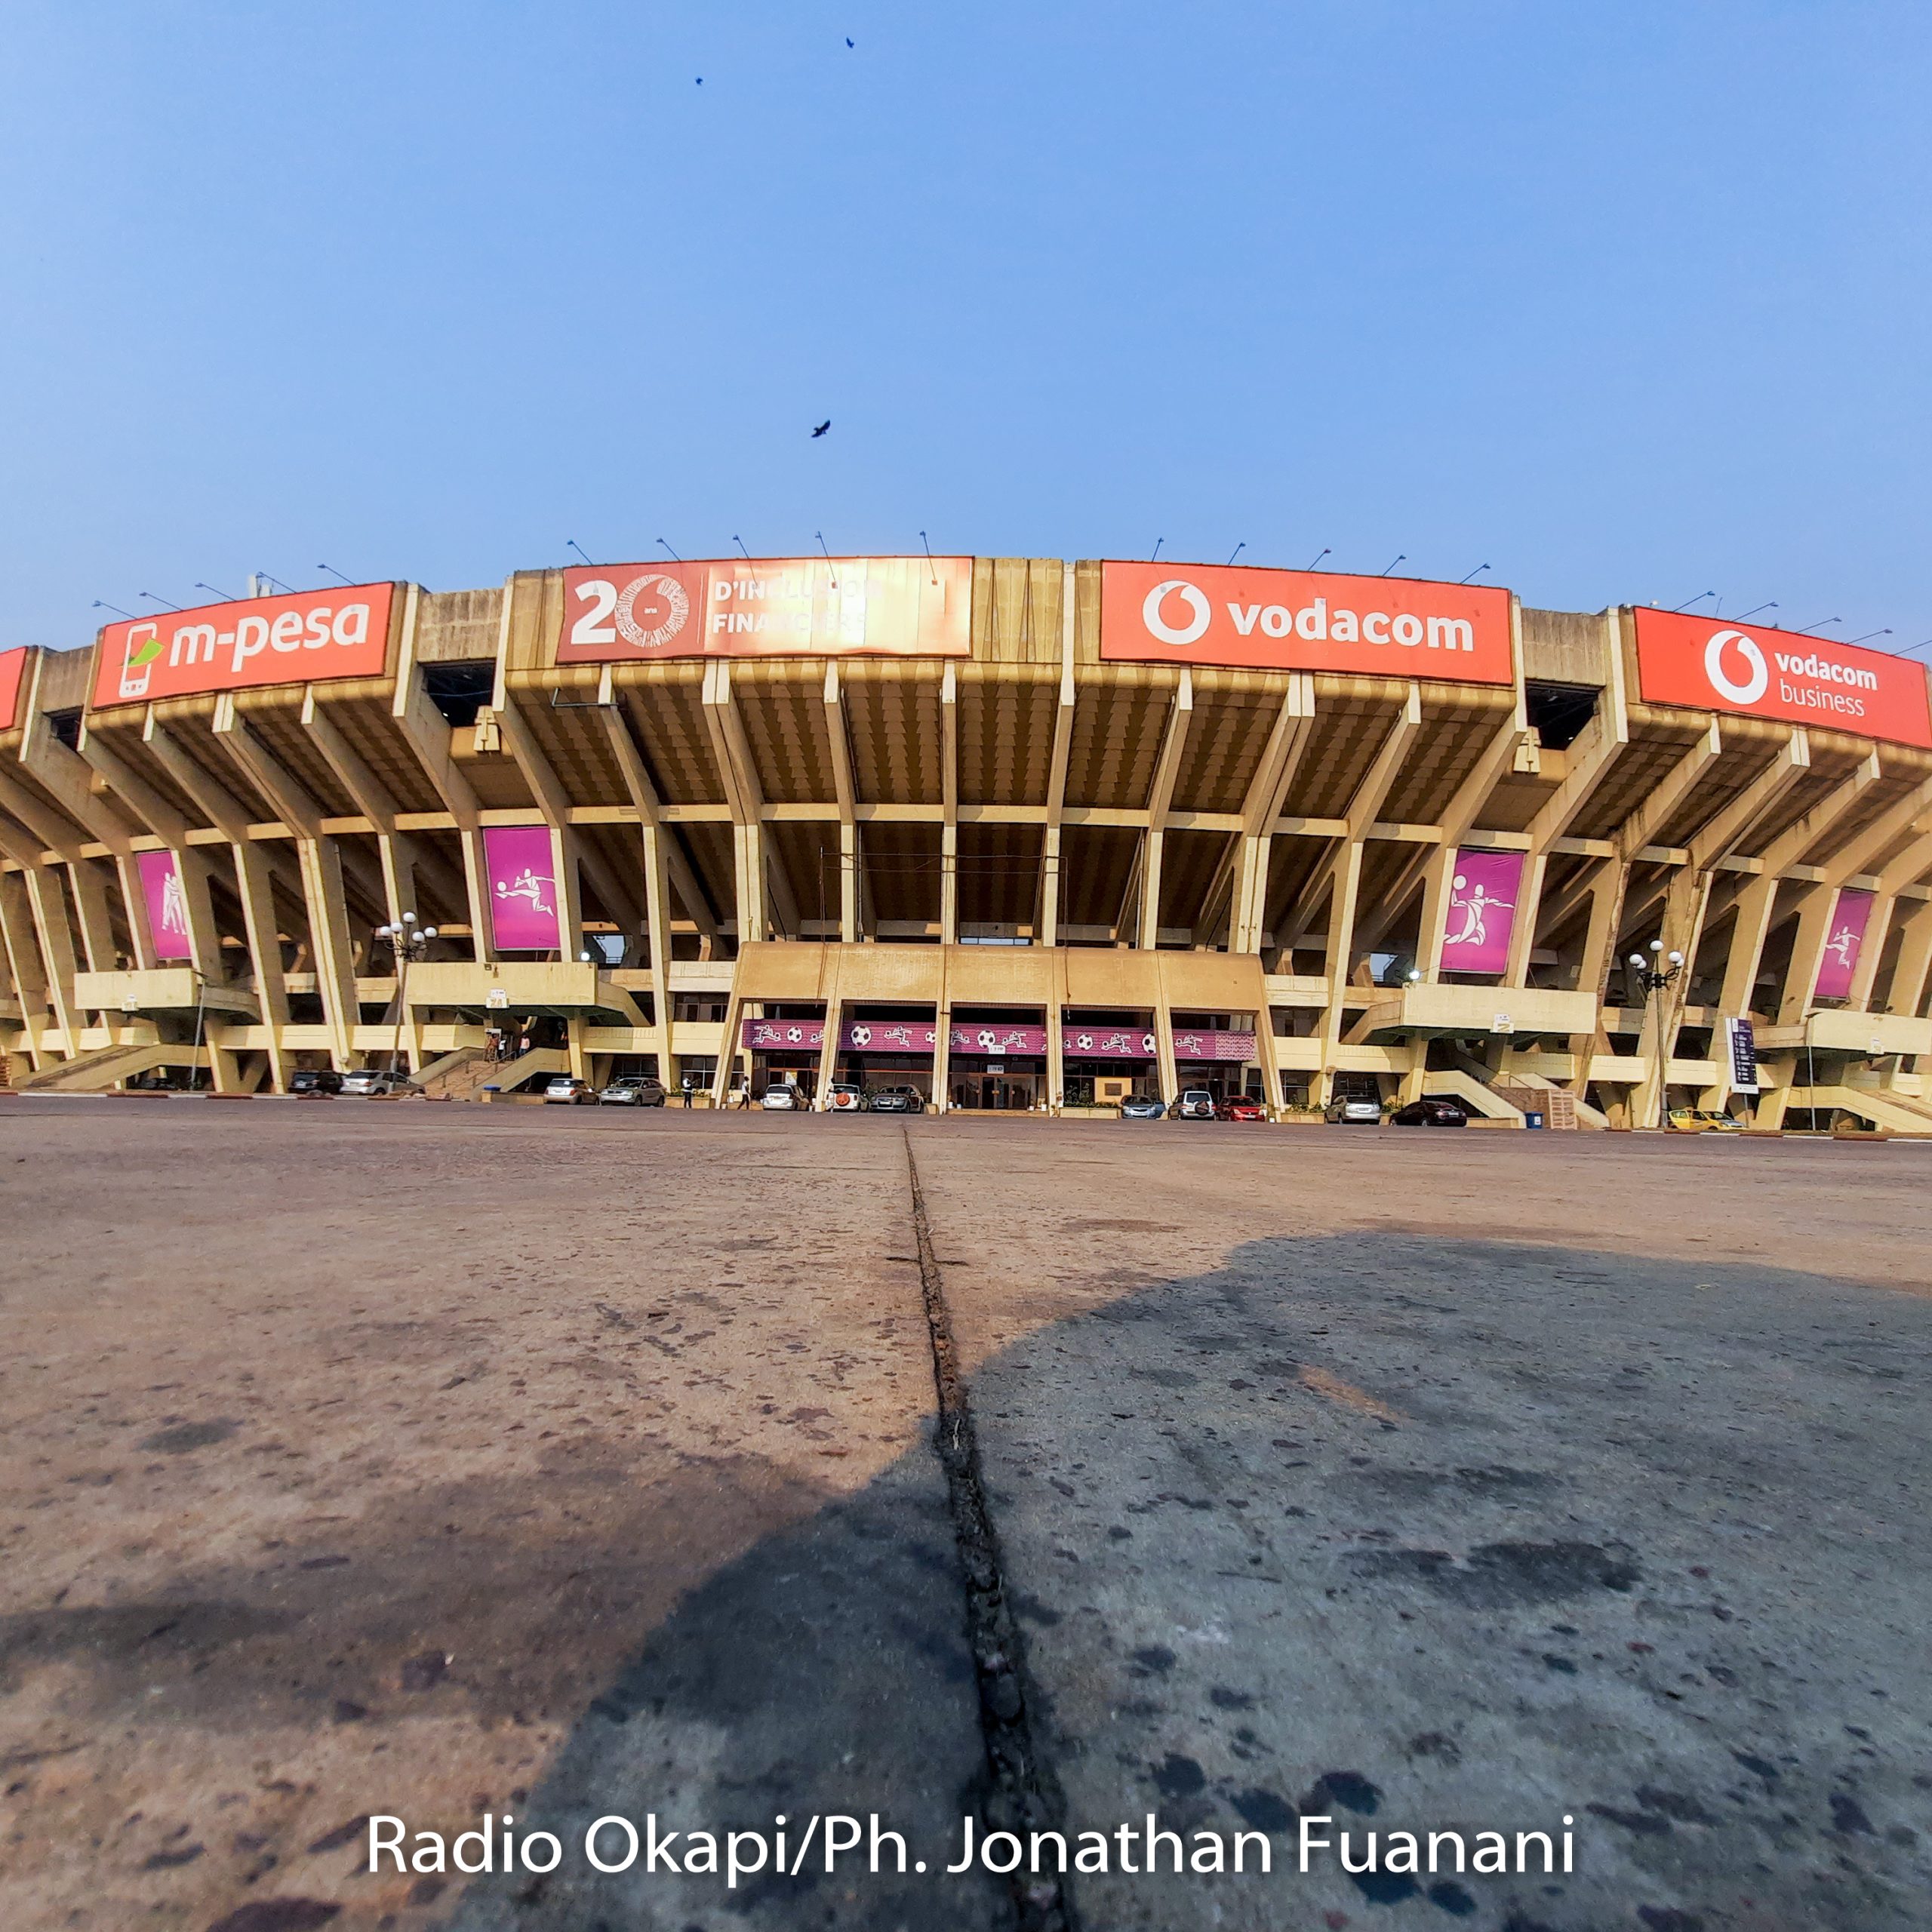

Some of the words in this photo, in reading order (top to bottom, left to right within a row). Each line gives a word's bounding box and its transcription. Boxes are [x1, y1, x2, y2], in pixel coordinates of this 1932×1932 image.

[570, 574, 690, 648] 20
[1226, 598, 1474, 651] vodacom
[169, 604, 370, 672] m-pesa
[1774, 653, 1878, 691] vodacom
[1780, 678, 1866, 717] business
